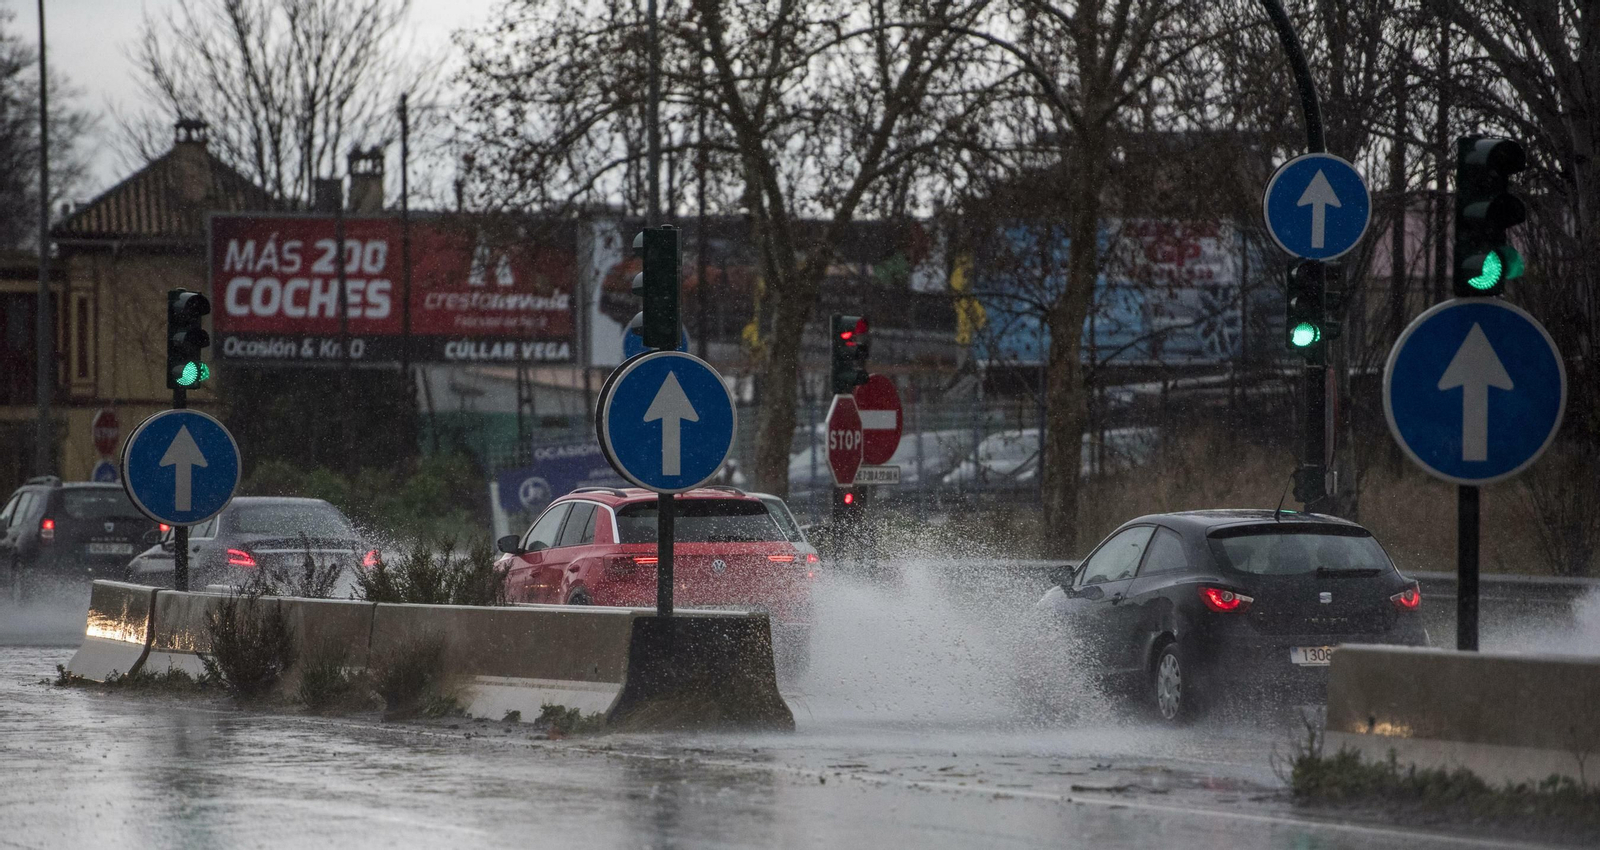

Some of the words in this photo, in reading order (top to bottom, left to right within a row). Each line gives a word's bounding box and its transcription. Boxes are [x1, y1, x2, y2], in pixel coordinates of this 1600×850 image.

[224, 232, 303, 273] MÁS
[311, 239, 389, 274] 200
[224, 276, 392, 319] COCHES
[223, 335, 297, 358] Ocasión
[300, 337, 314, 358] &
[521, 341, 571, 360] VEGA
[830, 430, 861, 450] STOP
[1302, 648, 1332, 662] 1308
